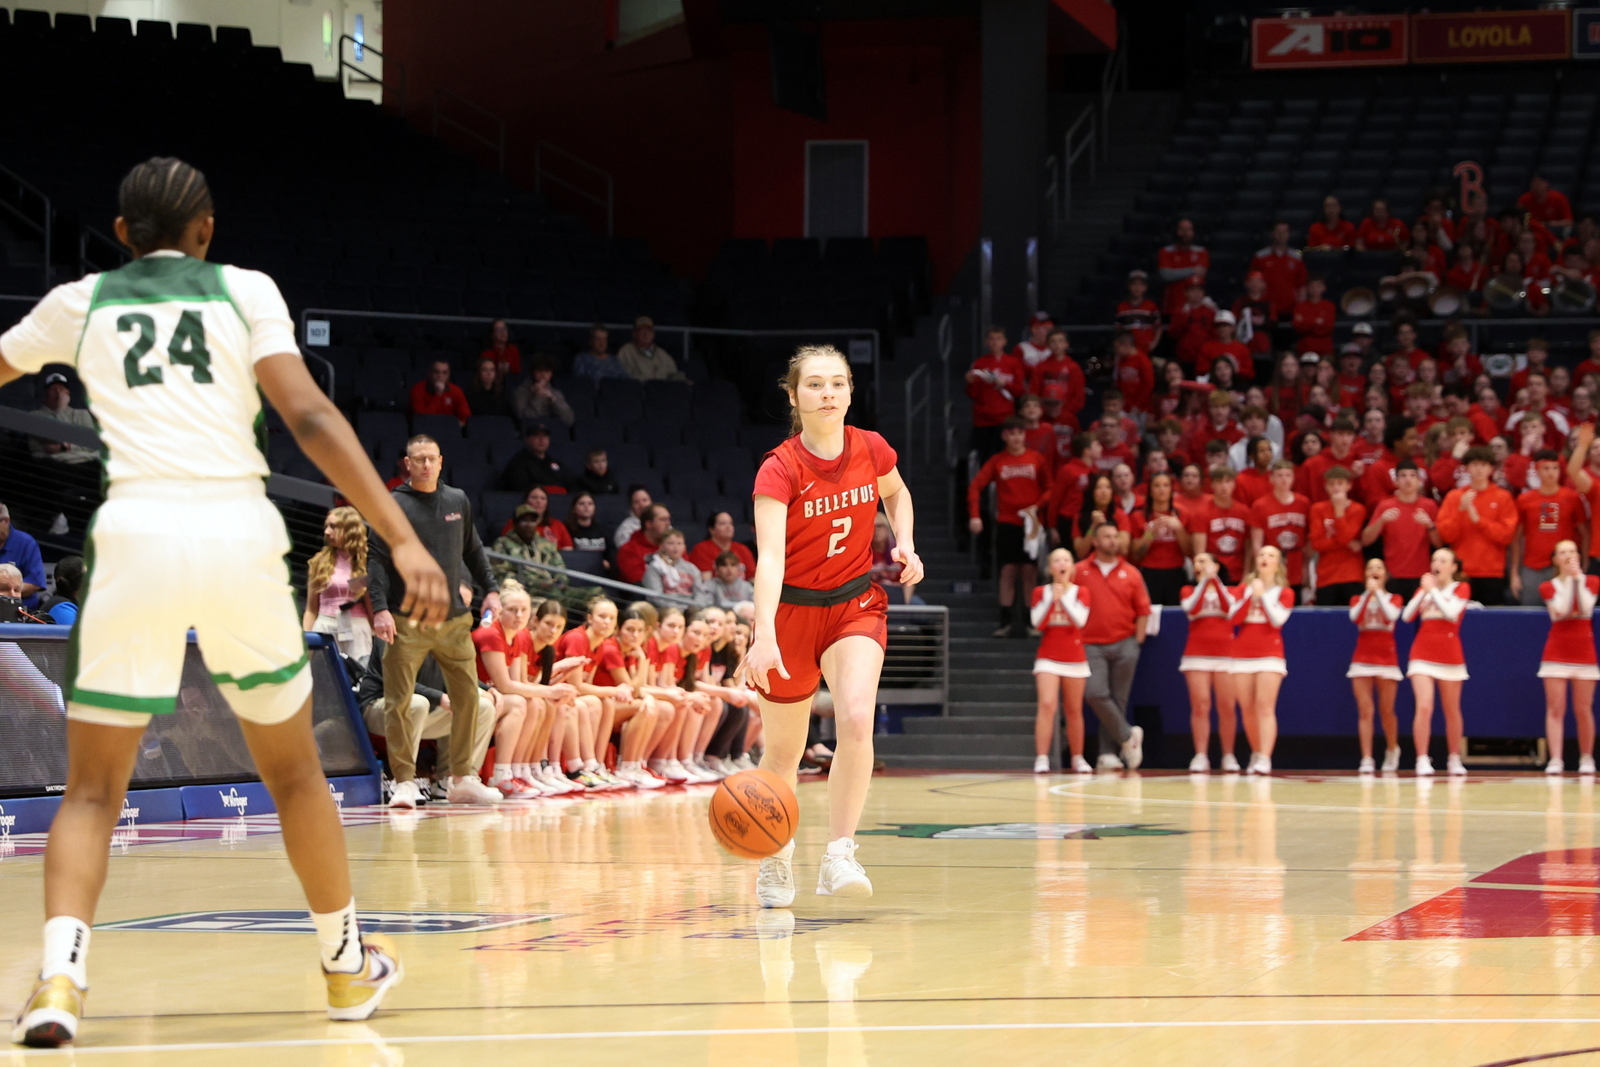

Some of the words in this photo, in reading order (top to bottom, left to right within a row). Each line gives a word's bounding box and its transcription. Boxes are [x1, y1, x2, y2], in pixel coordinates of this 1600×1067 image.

[1447, 24, 1533, 48] LOYOLA
[116, 309, 213, 389] 24
[804, 483, 875, 518] BELLEVUE
[826, 515, 853, 558] 2
